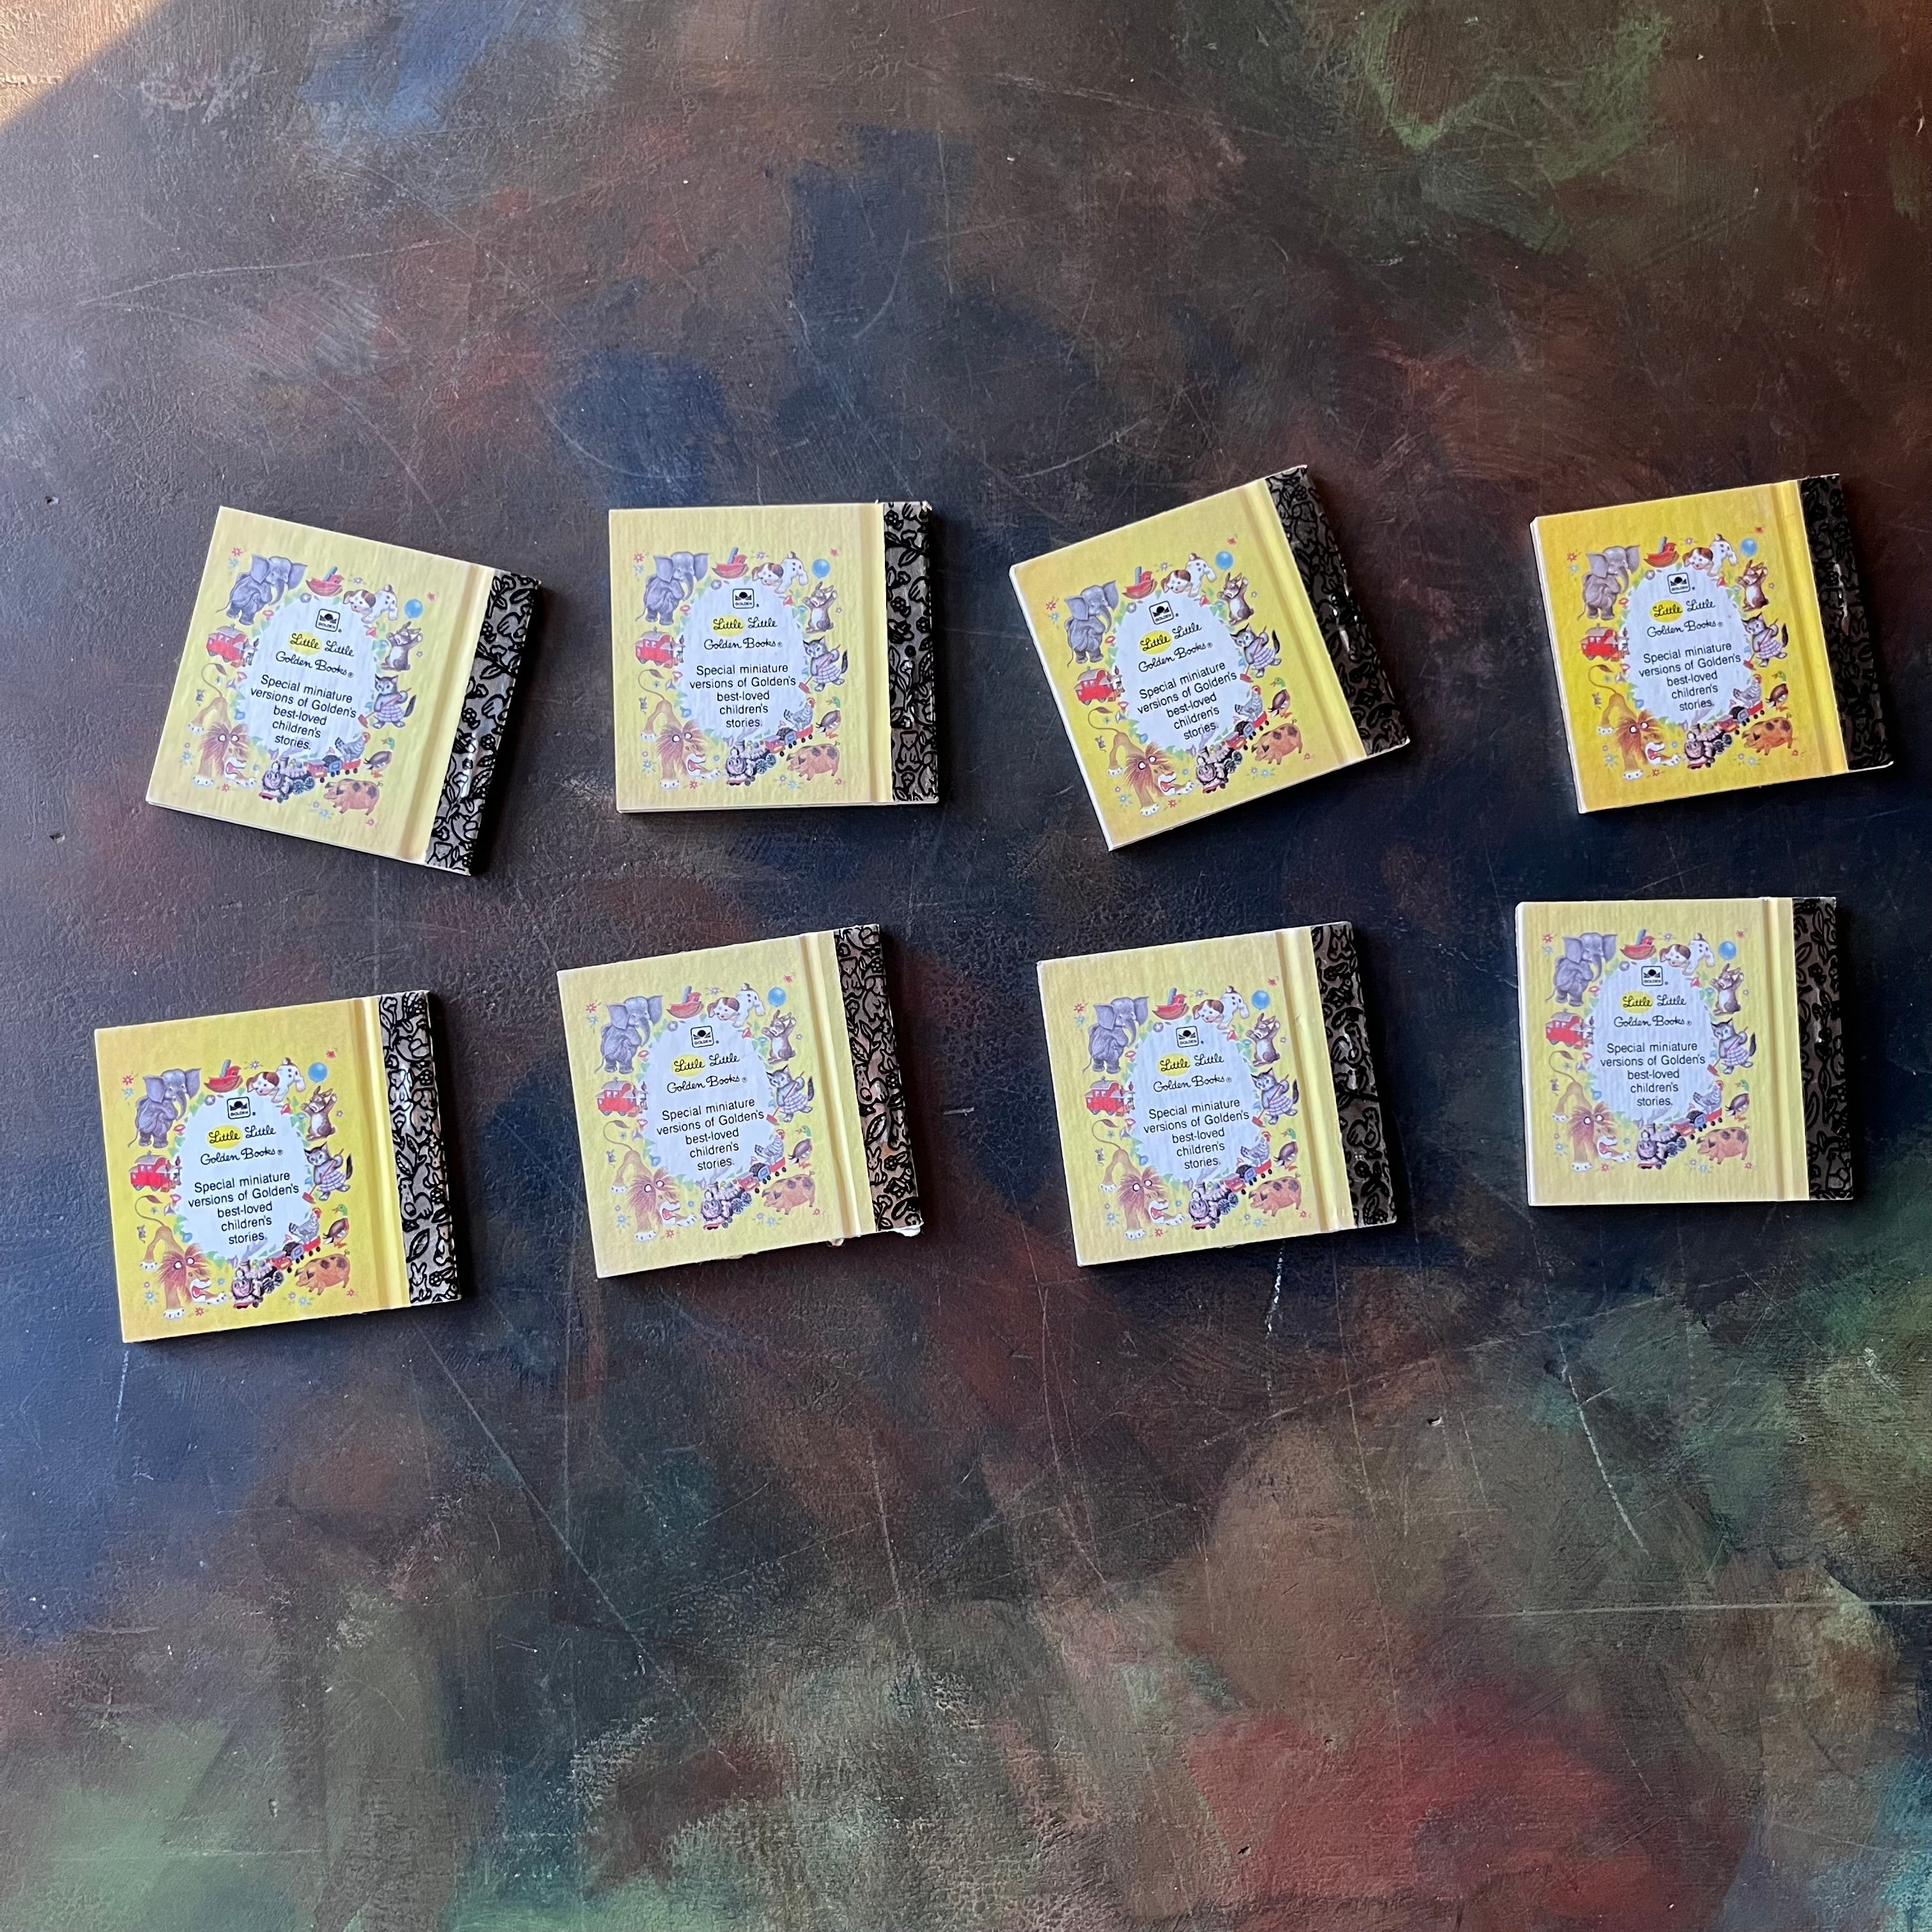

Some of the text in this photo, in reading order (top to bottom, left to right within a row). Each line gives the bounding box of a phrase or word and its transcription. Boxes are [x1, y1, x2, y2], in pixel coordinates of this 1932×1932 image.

[1652, 599, 1716, 618] Little Little
[713, 616, 778, 631] Little Little
[1646, 625, 1684, 638] Golden
[289, 633, 355, 657] Little Little
[703, 638, 742, 650] Golden
[1140, 622, 1202, 652] Little Little
[275, 651, 313, 669] Golden
[1643, 643, 1732, 665] Special miniature
[696, 664, 788, 677] Special miniature
[1138, 657, 1175, 673] Golden
[1638, 653, 1742, 677] versions of Golden's
[689, 675, 796, 689] versions of Golden's
[1139, 662, 1226, 701] Special miniature
[1666, 670, 1718, 687] best-loved
[260, 674, 353, 703] Special miniature
[717, 690, 770, 702] best-loved
[1137, 671, 1238, 714] versions of Golden's
[1671, 684, 1719, 700] children's
[250, 688, 356, 718] versions of Golden's
[719, 704, 769, 715] children's
[1165, 691, 1217, 718] best-loved
[1679, 702, 1715, 711] stories.
[273, 706, 327, 726] best-loved
[726, 717, 763, 728] stories.
[1174, 706, 1220, 730] children's
[272, 719, 321, 739] children's
[1183, 721, 1219, 740] stories.
[274, 735, 311, 750] stories.
[1622, 994, 1687, 1008] Little Little
[1613, 1016, 1652, 1027] Golden
[1606, 1041, 1698, 1055] Special miniature
[673, 1053, 740, 1073] Little Little
[1160, 1053, 1225, 1072] Little Little
[1600, 1055, 1705, 1067] versions of Golden's
[1627, 1069, 1680, 1080] best-loved
[666, 1081, 706, 1094] Golden
[1153, 1081, 1192, 1092] Golden
[1630, 1082, 1678, 1093] children's
[662, 1098, 755, 1123] Special miniature
[1149, 1098, 1240, 1121] Special miniature
[1637, 1097, 1673, 1107] stories.
[656, 1109, 765, 1135] versions of Golden's
[1143, 1110, 1250, 1133] versions of Golden's
[208, 1124, 277, 1144] Little Little
[685, 1127, 739, 1145] best-loved
[1172, 1127, 1225, 1144] best-loved
[689, 1142, 739, 1158] children's
[1176, 1142, 1225, 1157] children's
[200, 1152, 240, 1165] Golden
[697, 1158, 735, 1171] stories.
[1184, 1158, 1222, 1170] stories.
[194, 1172, 291, 1195] Special miniature
[188, 1183, 300, 1208] versions of Golden's
[217, 1200, 273, 1218] best-loved
[221, 1215, 272, 1232] children's
[228, 1232, 268, 1245] stories.
